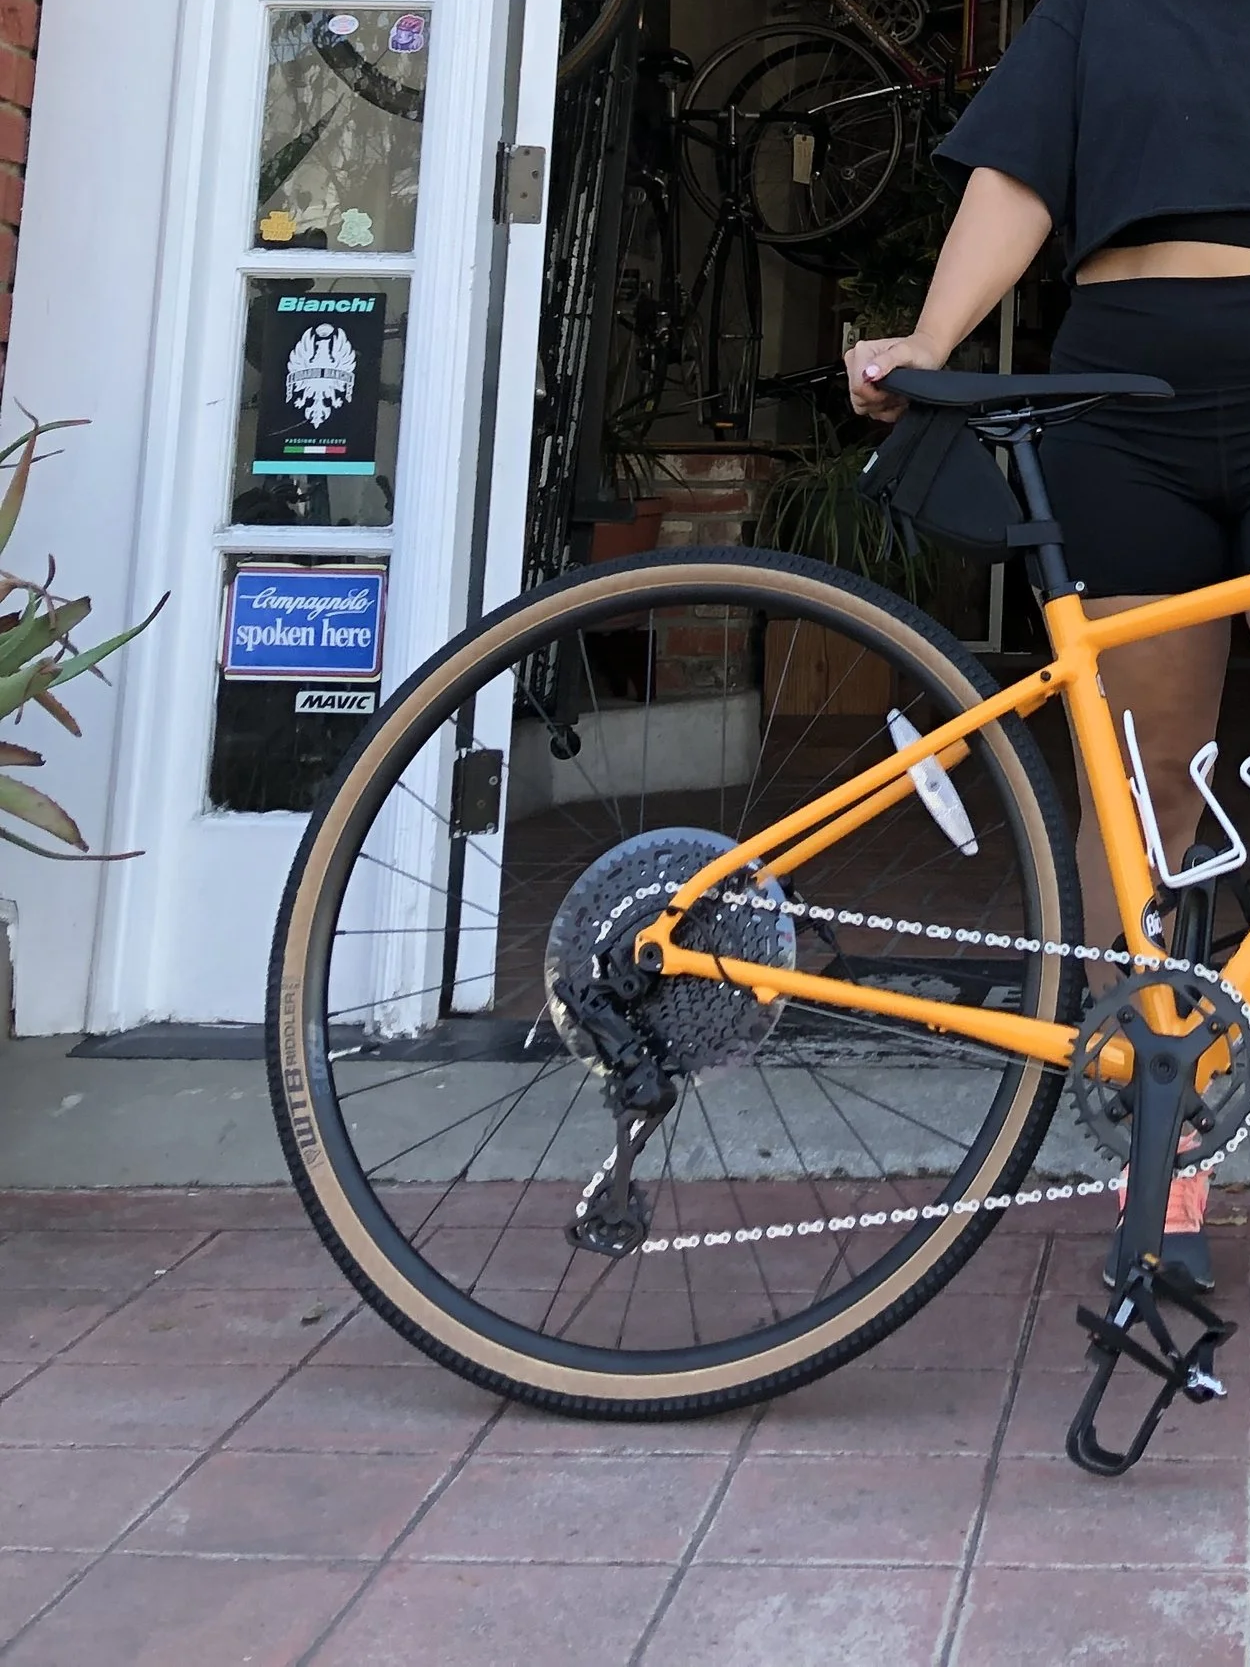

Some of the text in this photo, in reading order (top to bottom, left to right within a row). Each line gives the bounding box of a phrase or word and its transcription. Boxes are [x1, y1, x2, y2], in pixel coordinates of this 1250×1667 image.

[277, 297, 376, 312] Bianchi
[240, 587, 375, 621] Campagnolo
[235, 617, 372, 652] spoken here
[300, 695, 371, 710] MAVIC
[283, 992, 298, 1066] RIDDLER
[284, 1067, 317, 1149] WTB
